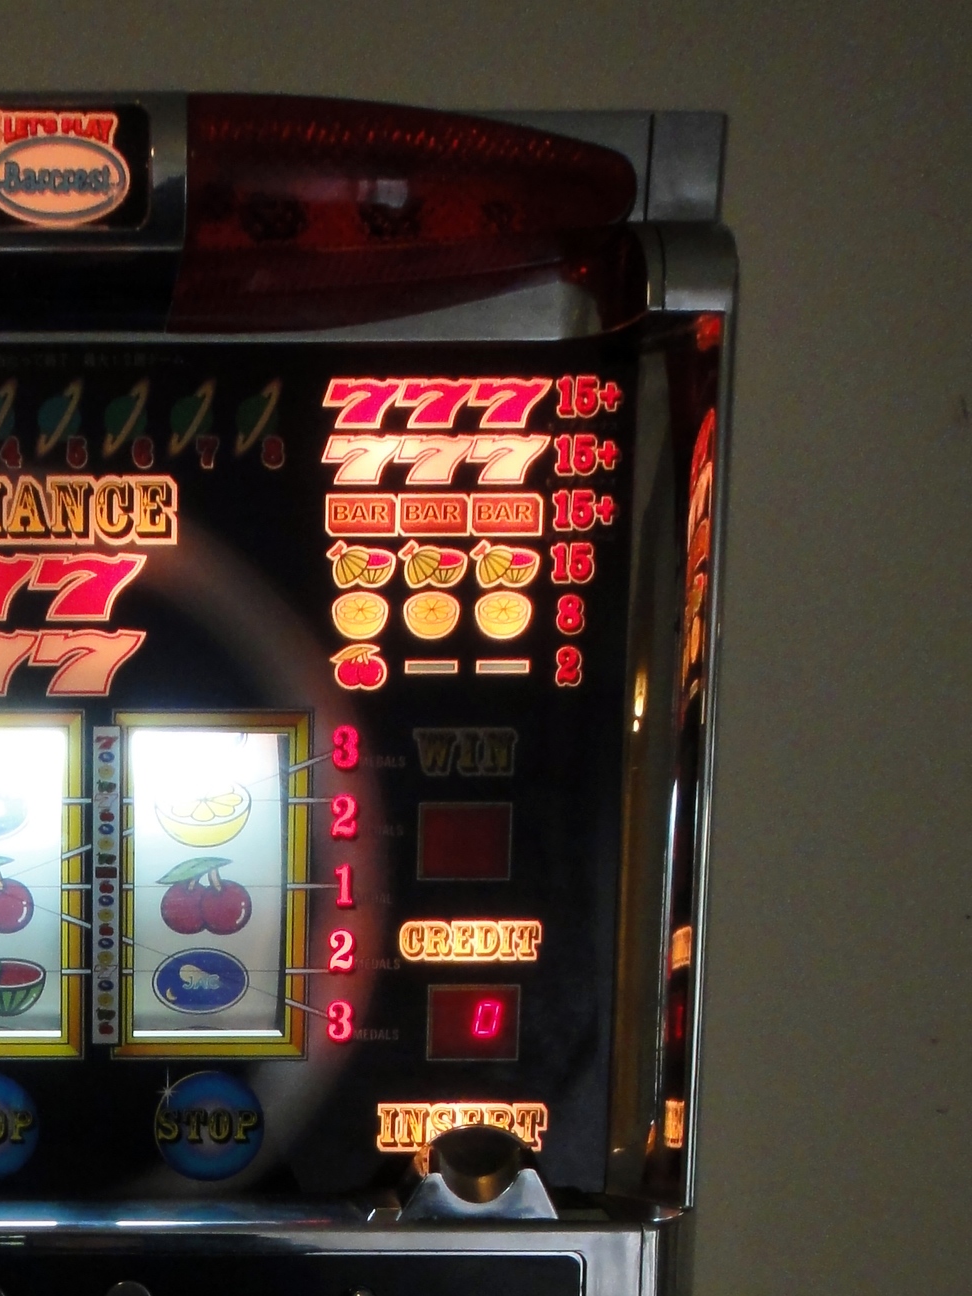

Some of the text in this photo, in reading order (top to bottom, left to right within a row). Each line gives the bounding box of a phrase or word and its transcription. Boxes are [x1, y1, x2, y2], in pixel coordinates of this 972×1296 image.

[2, 115, 115, 142] LET'S PLAY
[556, 376, 621, 418] 15+
[554, 434, 617, 476] 15+
[333, 503, 389, 522] BAR
[404, 503, 461, 522] BAR
[477, 503, 533, 522] BAR
[552, 490, 615, 531] 15+
[551, 542, 594, 583] 15
[555, 594, 584, 634] 8
[554, 646, 582, 686] 2
[331, 725, 359, 769] 3
[412, 728, 517, 776] WIN
[331, 794, 357, 840] 2
[335, 863, 355, 908] 1
[329, 930, 355, 973] 2
[399, 921, 541, 962] CREDIT
[328, 1001, 354, 1042] 3
[474, 1000, 501, 1037] 0
[157, 1108, 259, 1141] STOP
